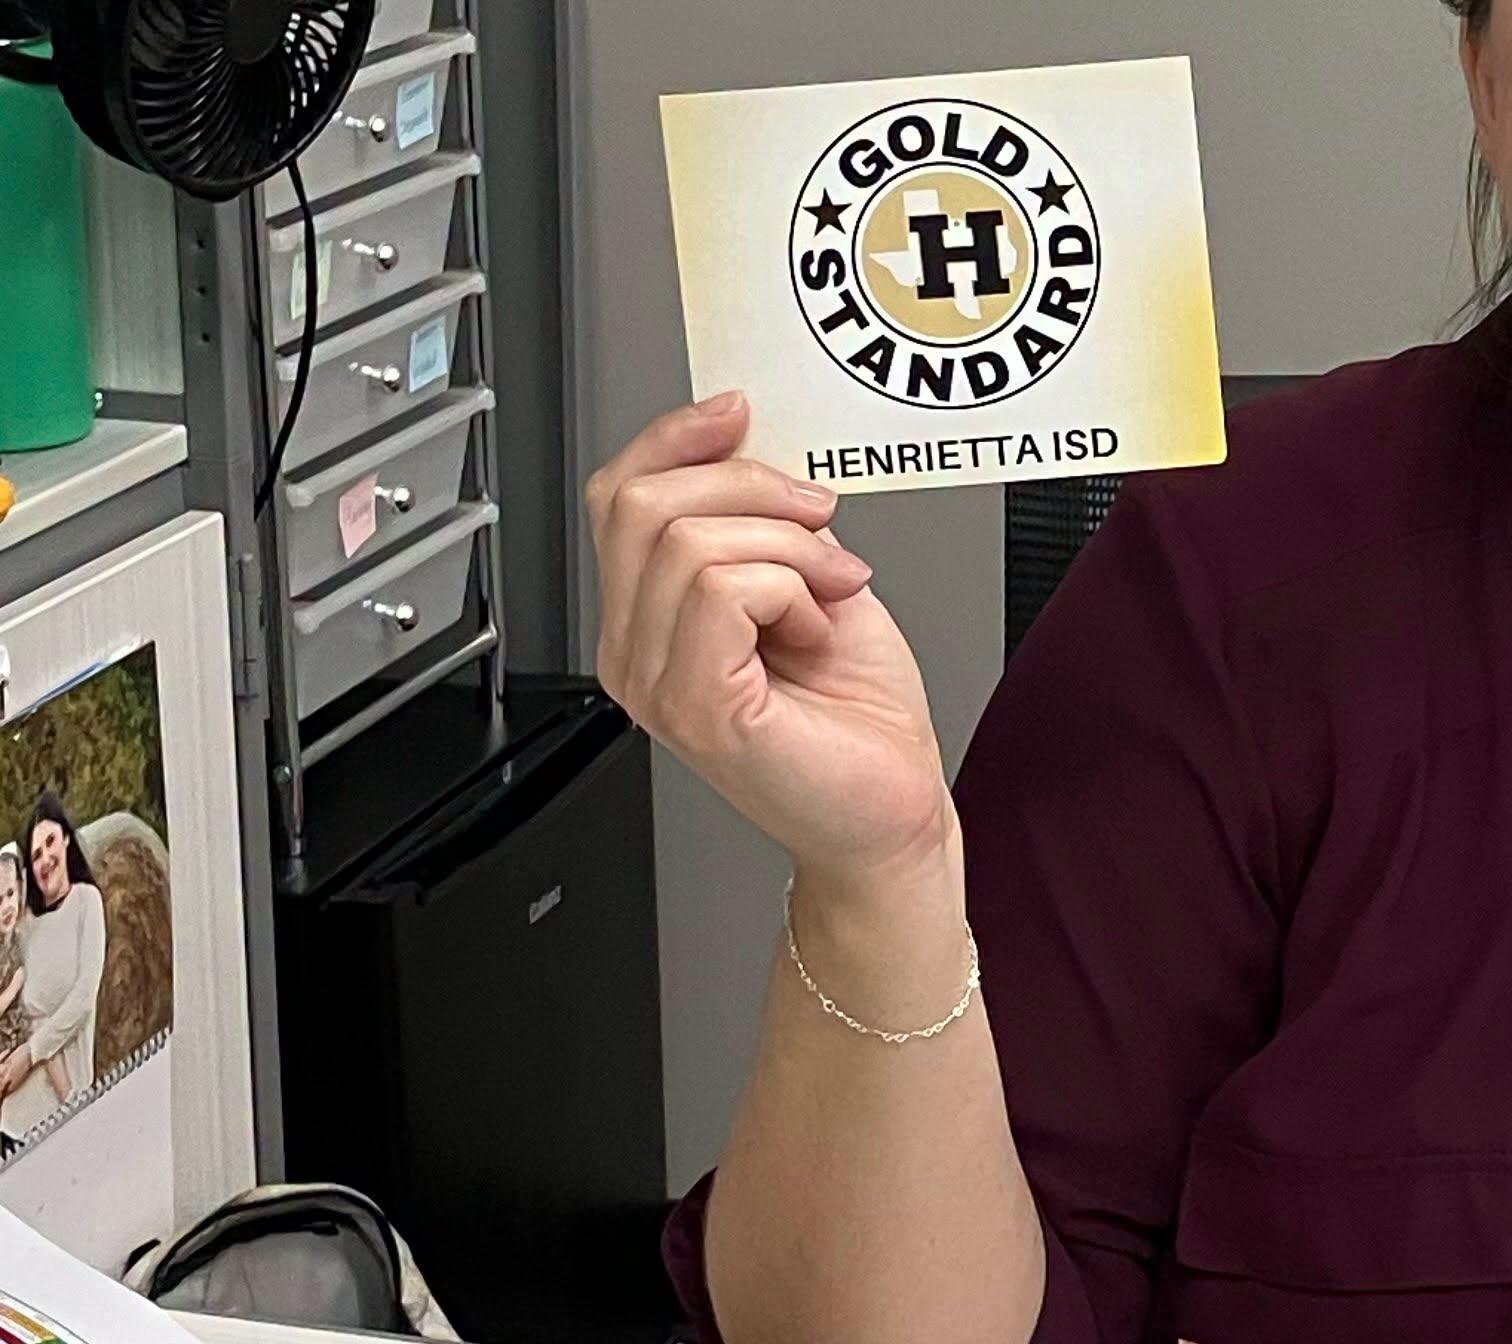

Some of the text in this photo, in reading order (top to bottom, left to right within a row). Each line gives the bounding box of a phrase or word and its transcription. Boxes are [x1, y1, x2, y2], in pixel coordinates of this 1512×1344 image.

[838, 112, 1030, 189] GOLD
[908, 210, 1011, 301] H
[800, 223, 1094, 402] STANDARD
[806, 427, 1119, 481] HENRIETTA ISD
